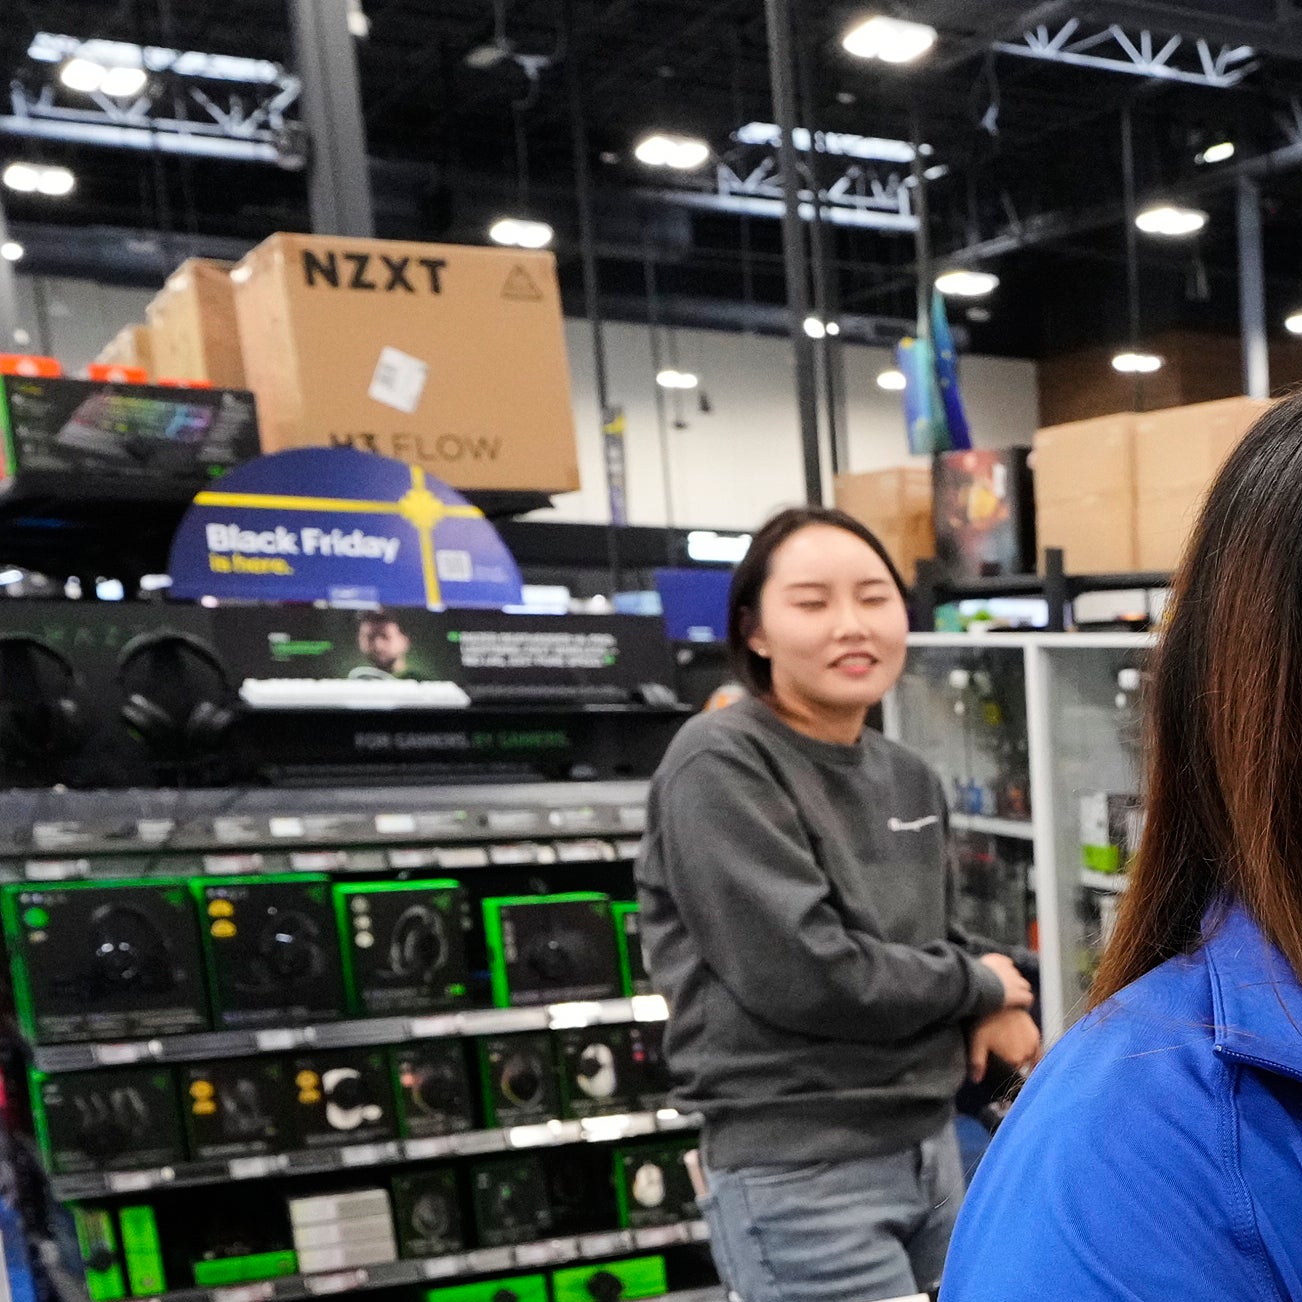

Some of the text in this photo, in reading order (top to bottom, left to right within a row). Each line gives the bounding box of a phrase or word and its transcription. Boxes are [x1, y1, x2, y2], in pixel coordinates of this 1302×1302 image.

[302, 249, 447, 294] NZXT
[391, 432, 503, 461] FLOW
[205, 522, 400, 564] Black Friday
